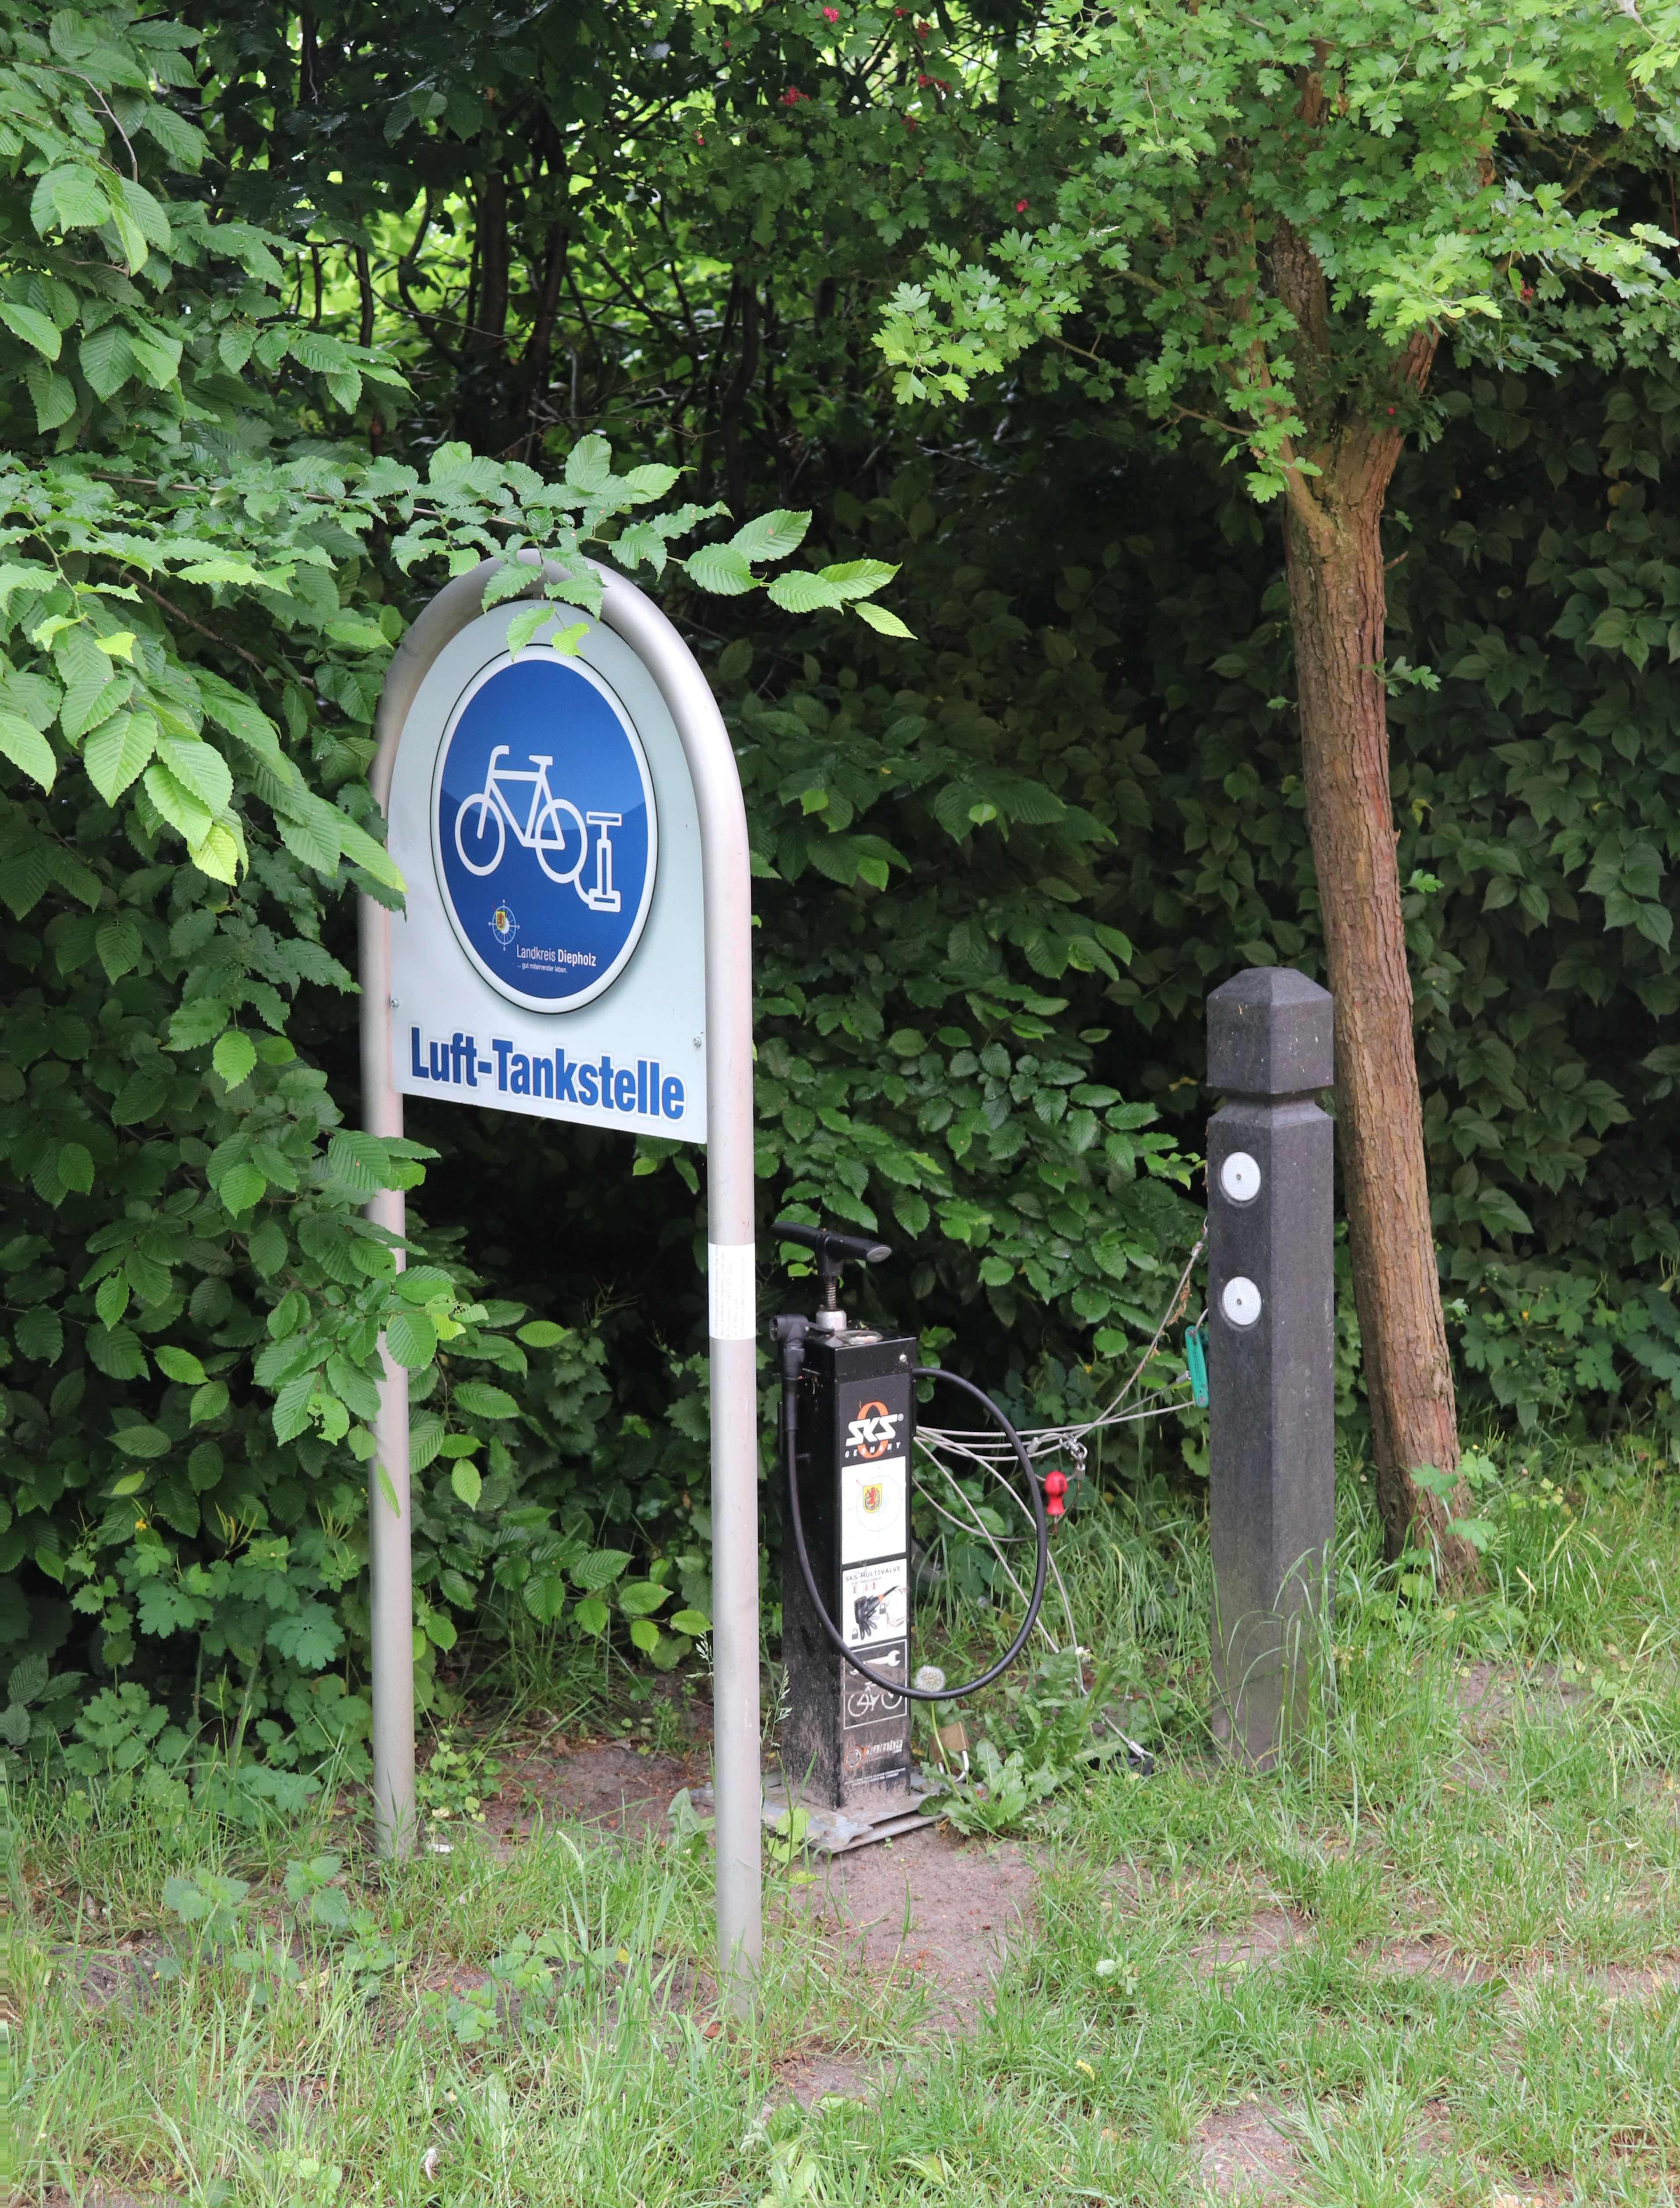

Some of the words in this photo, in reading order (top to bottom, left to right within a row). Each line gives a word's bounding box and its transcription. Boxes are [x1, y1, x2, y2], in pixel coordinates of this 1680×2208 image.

[516, 944, 556, 962] Landkreis
[558, 949, 596, 967] Diepholz
[529, 963, 554, 972] miteinander
[411, 1027, 685, 1120] Luft-Tankstelle
[846, 1414, 898, 1446] SKS
[845, 1441, 901, 1458] GERMANY
[845, 1565, 901, 1582] SKS-MULTIVALVE
